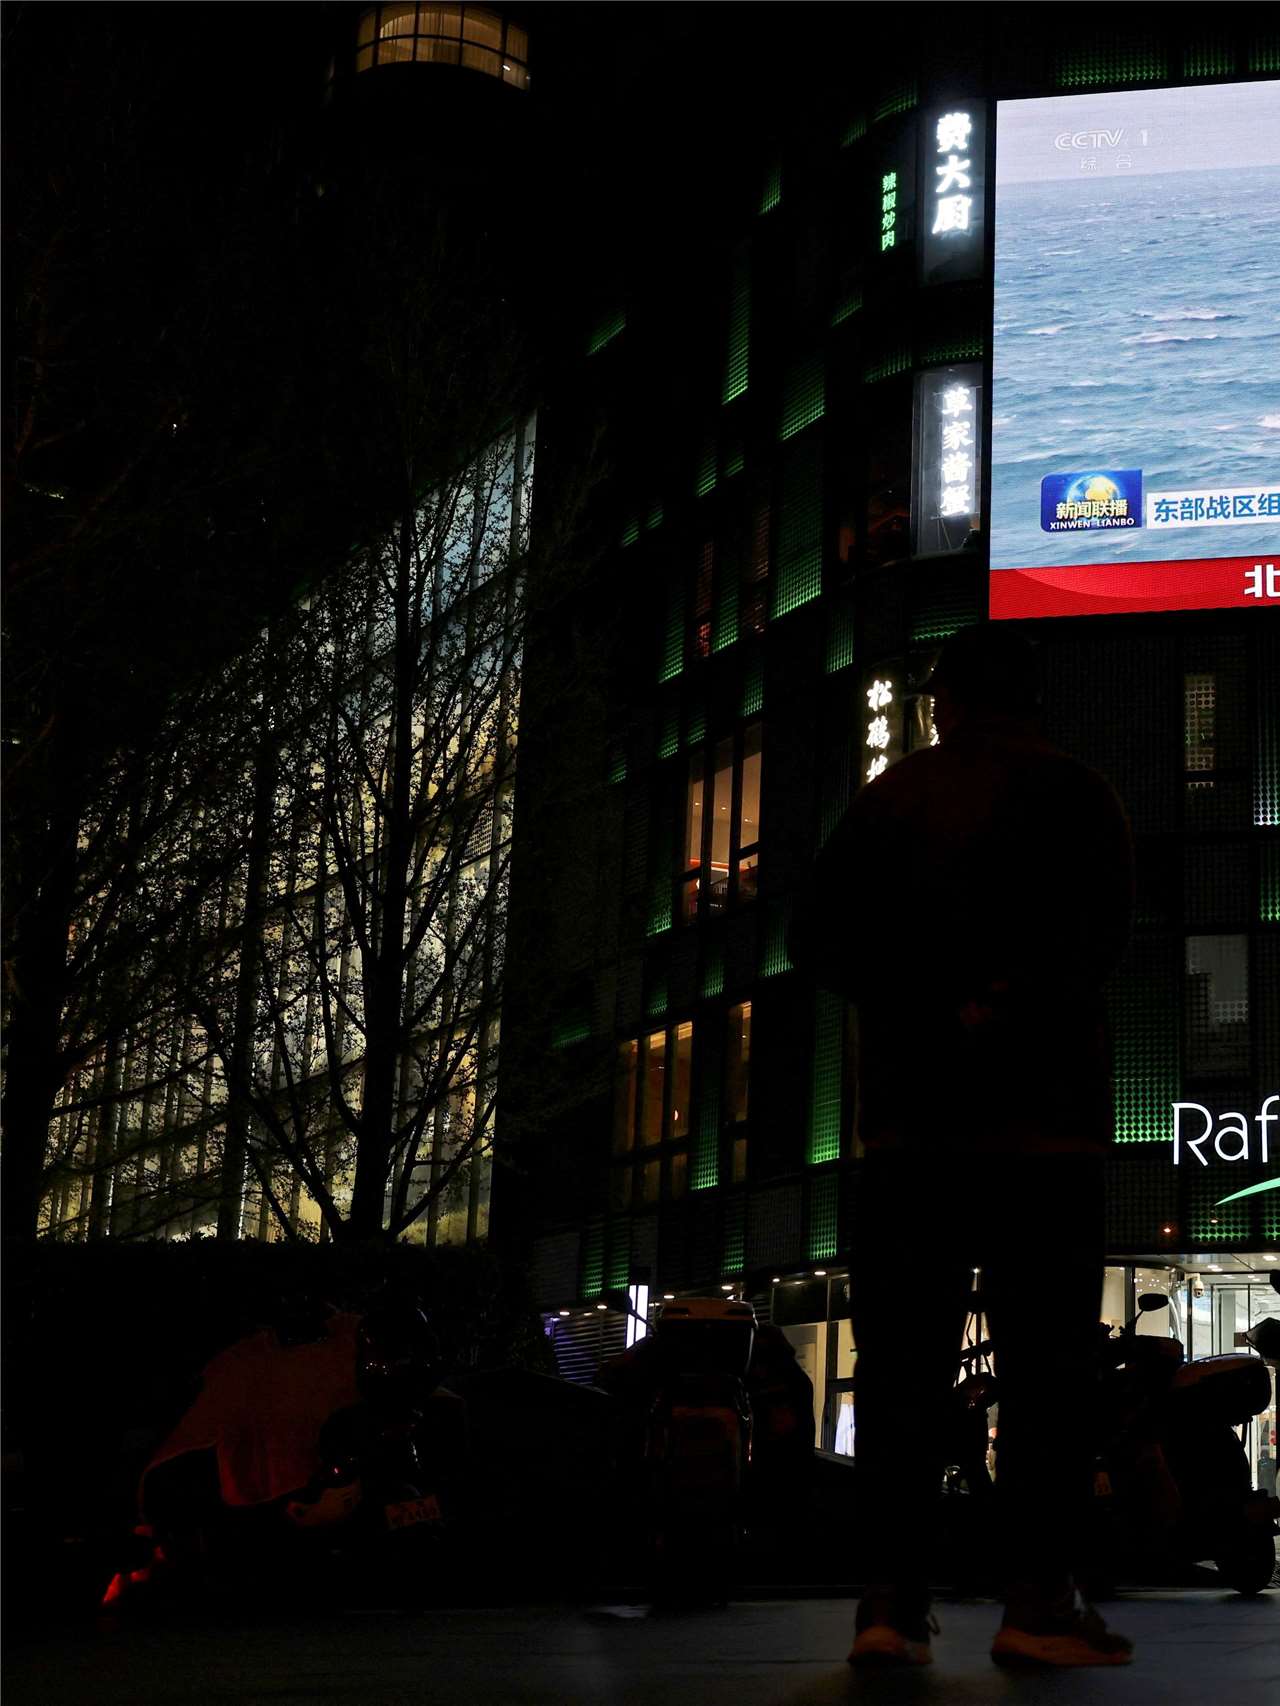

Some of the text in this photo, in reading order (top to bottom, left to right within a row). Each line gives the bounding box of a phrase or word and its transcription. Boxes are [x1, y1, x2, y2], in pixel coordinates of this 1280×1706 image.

[1055, 128, 1123, 151] CCTV
[882, 172, 897, 251] 辣椒炒肉
[1055, 499, 1128, 520] 新闻联播
[1050, 517, 1135, 530] XINWEN LIANBO
